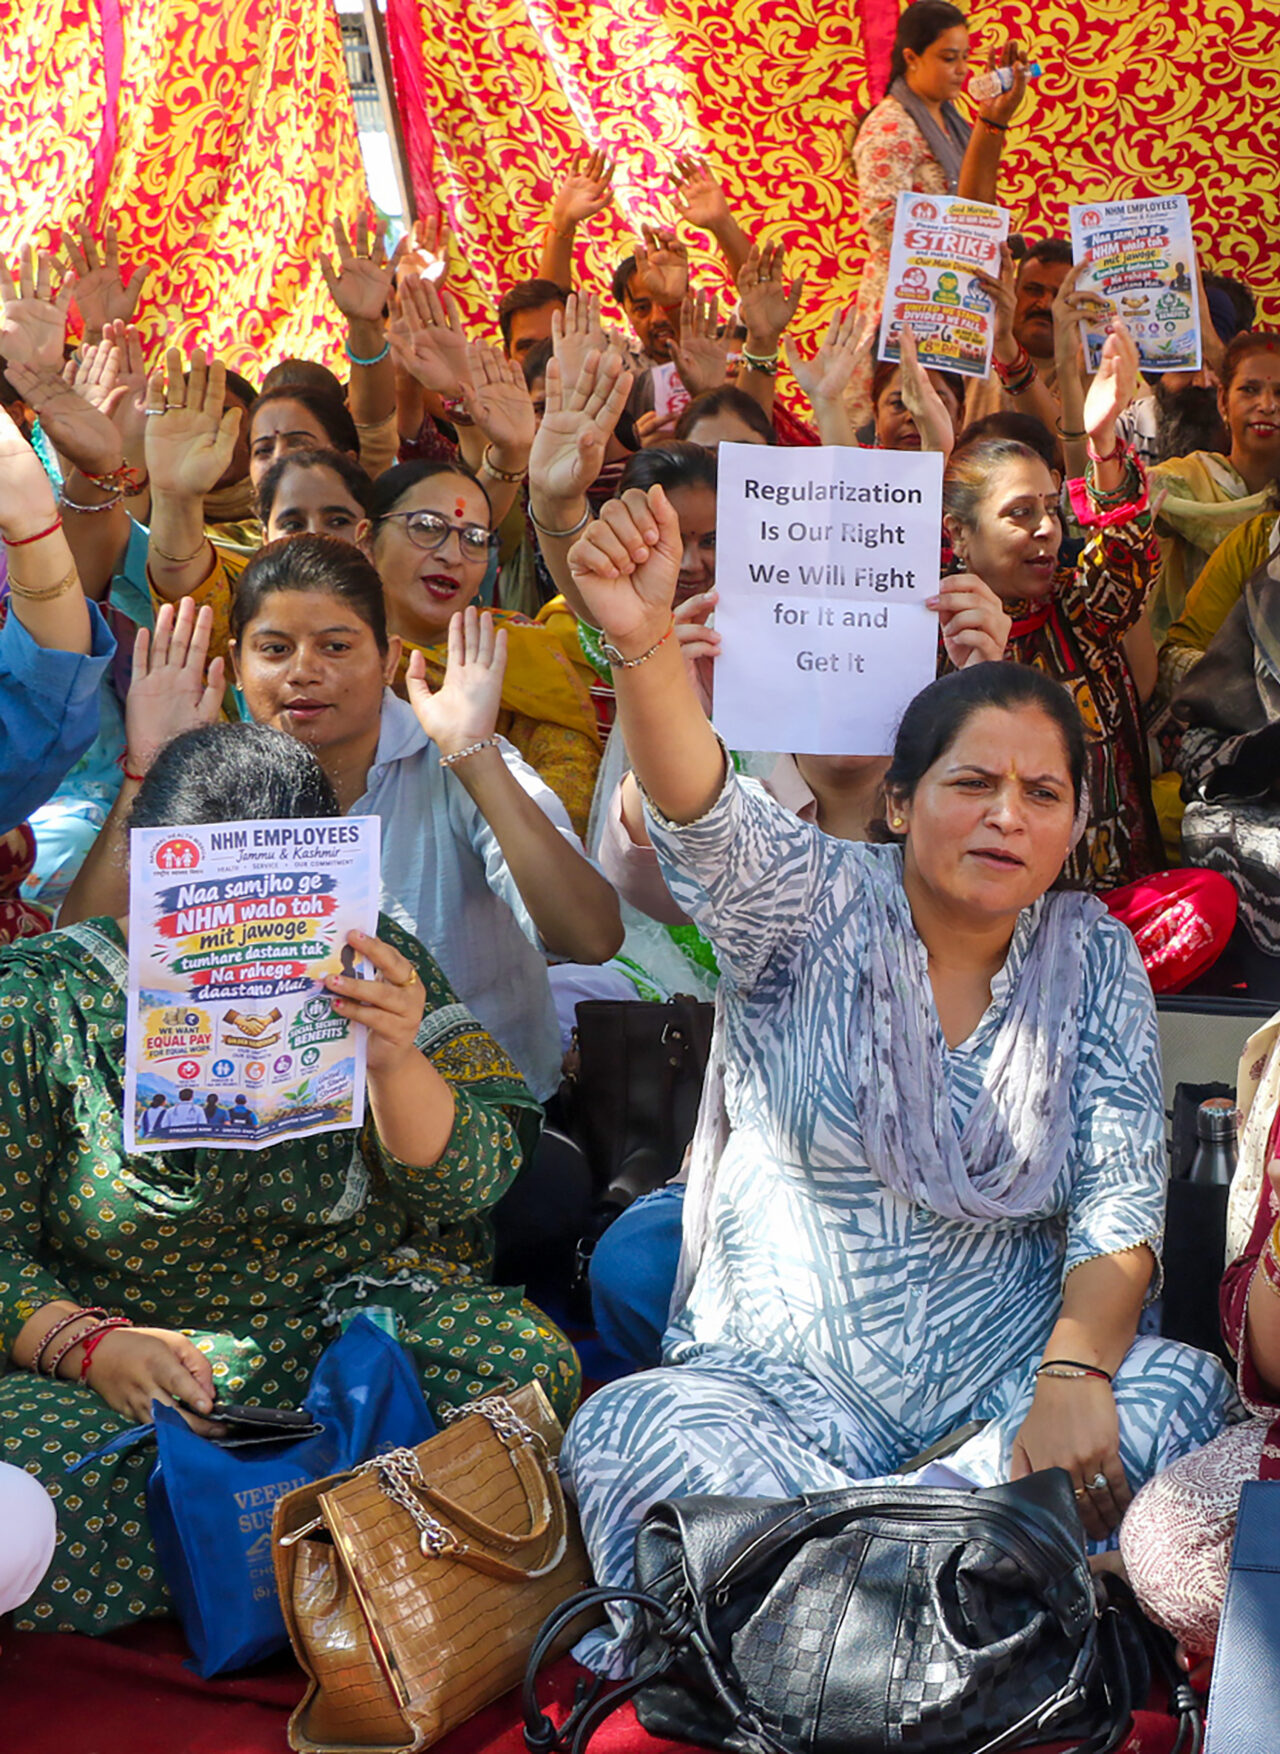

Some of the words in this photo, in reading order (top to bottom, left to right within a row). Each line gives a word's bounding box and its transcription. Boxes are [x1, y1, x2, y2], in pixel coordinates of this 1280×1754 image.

[1105, 206, 1125, 216] NHM
[1127, 200, 1178, 213] EMPLOYEES
[911, 231, 992, 259] STRIKE
[1092, 242, 1119, 260] NHM
[1104, 255, 1120, 266] mit
[1123, 249, 1156, 263] jawoge
[903, 311, 945, 321] DIVIDED
[947, 316, 959, 325] WE
[904, 304, 940, 313] UNITED
[942, 306, 955, 315] WE
[744, 479, 922, 505] Regularization
[761, 521, 779, 541] Is
[788, 522, 833, 541] Our
[841, 522, 905, 548] Right
[749, 564, 790, 585] We
[799, 565, 845, 586] Will
[854, 567, 916, 592] Fight
[774, 603, 810, 625] for
[818, 606, 834, 627] It
[842, 607, 888, 628] and
[796, 651, 839, 673] Get
[848, 653, 865, 673] It
[211, 830, 247, 850] NHM
[253, 825, 359, 847] EMPLOYEES
[236, 849, 275, 863] Jammu
[280, 848, 288, 859] &
[292, 846, 341, 860] Kashmir
[177, 884, 219, 909] Naa
[224, 873, 293, 899] samjho
[297, 875, 323, 894] ge
[176, 903, 235, 934] NHM
[240, 898, 287, 921] walo
[291, 895, 323, 914] toh
[200, 927, 235, 949] mit
[238, 921, 307, 946] jawoge
[181, 951, 242, 970] tumhare
[245, 945, 298, 961] dastaan
[301, 943, 324, 956] tak
[211, 969, 234, 984] Na
[239, 962, 293, 980] rahege
[198, 984, 272, 1000] daastano
[147, 1036, 187, 1049] EQUAL
[189, 1033, 212, 1045] PAY
[294, 1027, 343, 1047] BENEFITS
